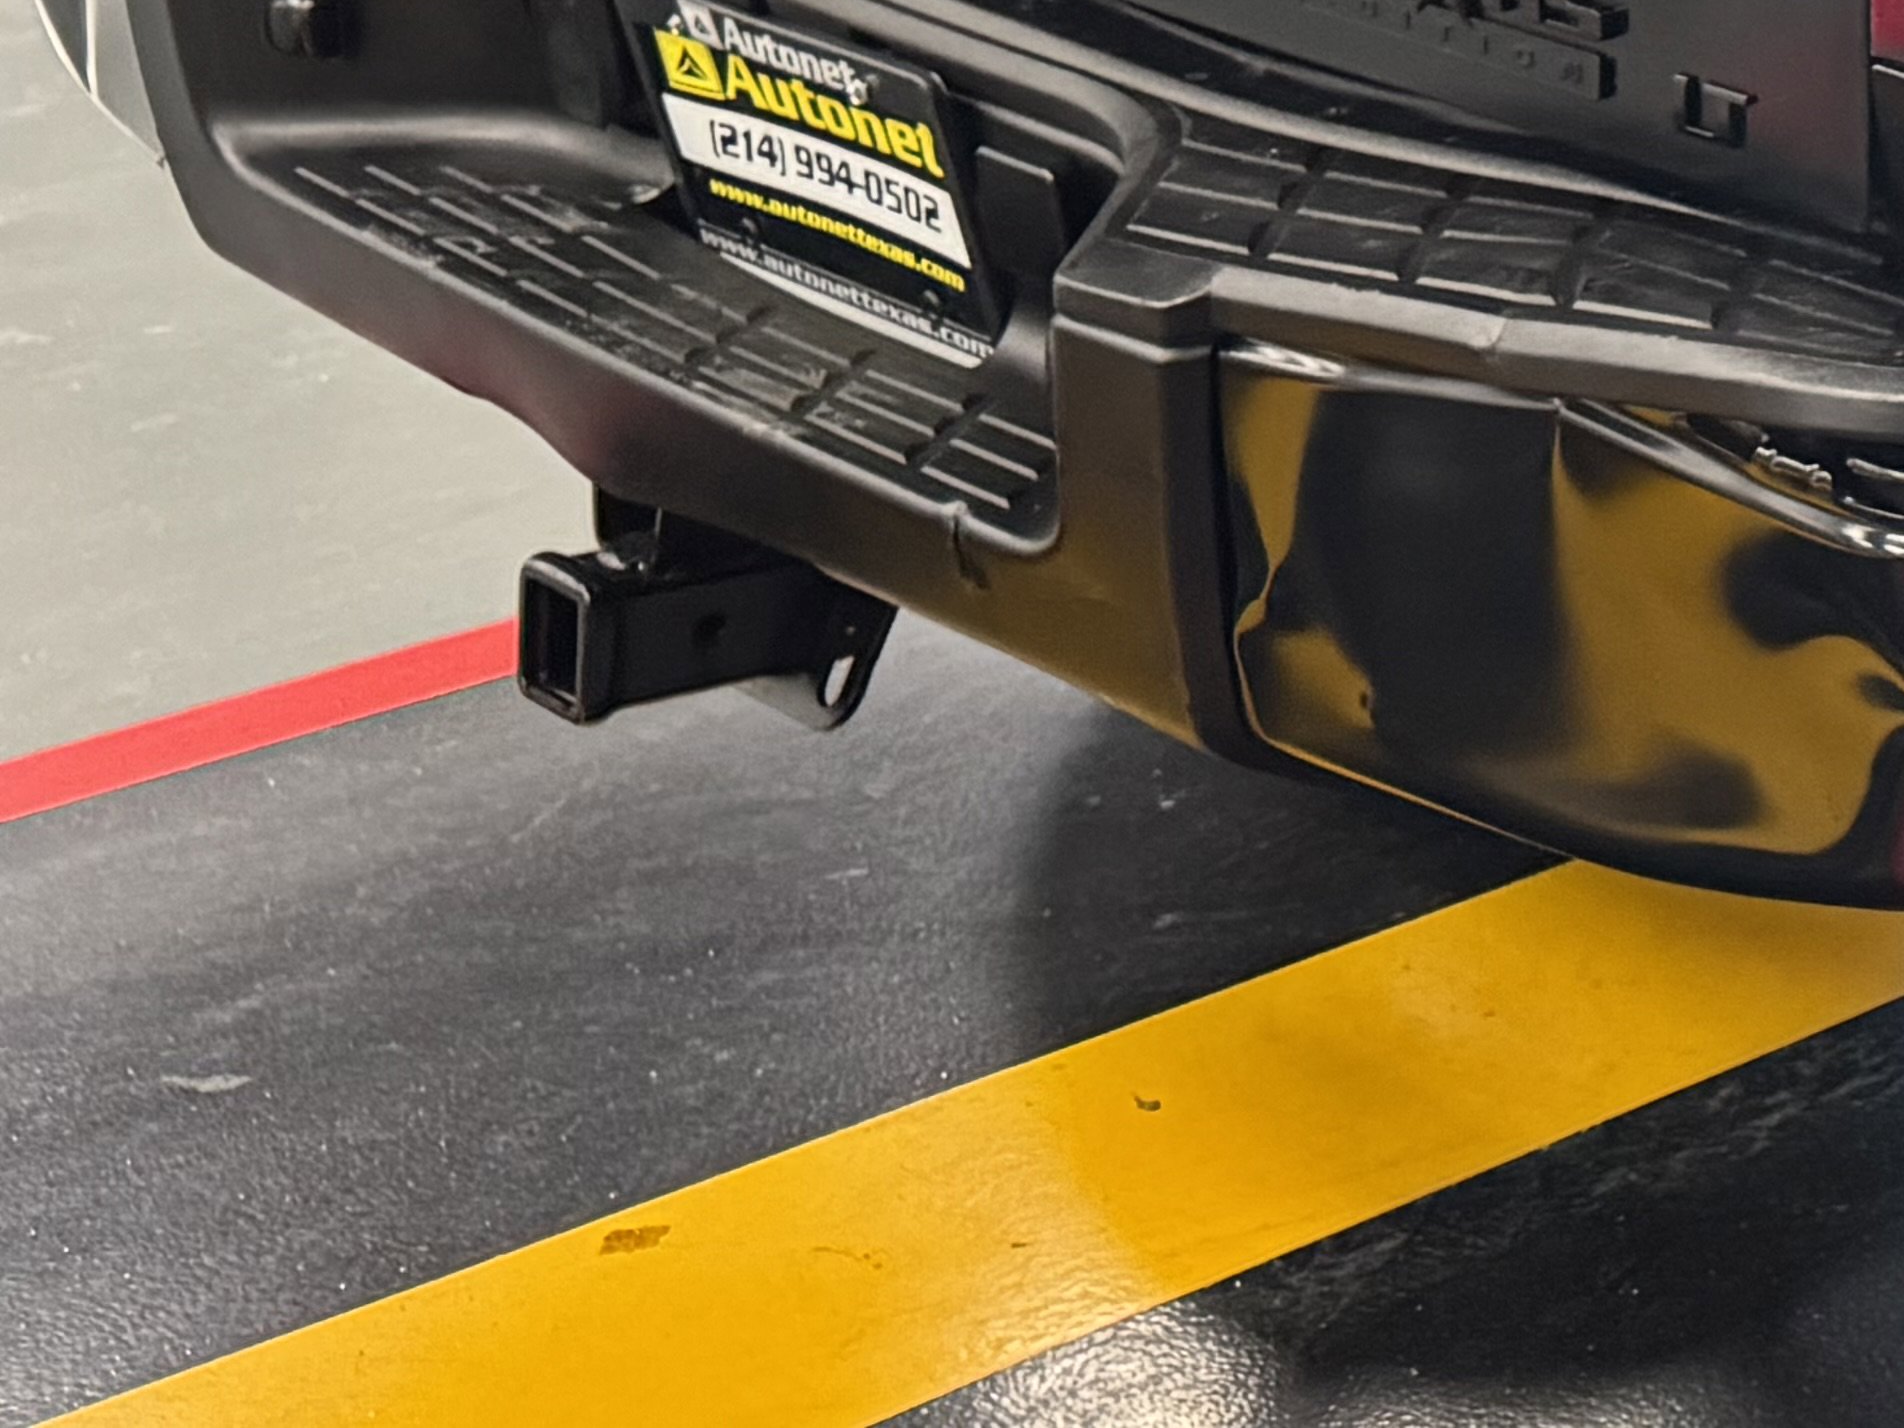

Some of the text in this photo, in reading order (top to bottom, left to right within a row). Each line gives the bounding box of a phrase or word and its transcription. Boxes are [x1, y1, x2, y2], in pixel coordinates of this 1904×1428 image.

[721, 16, 857, 93] Autonet
[1672, 70, 1759, 145] LT
[724, 53, 945, 179] Autonet
[709, 118, 943, 234] (214) 994-0502
[698, 227, 996, 359] www.autonettexas.com
[708, 177, 968, 294] www.autonettexas.com
